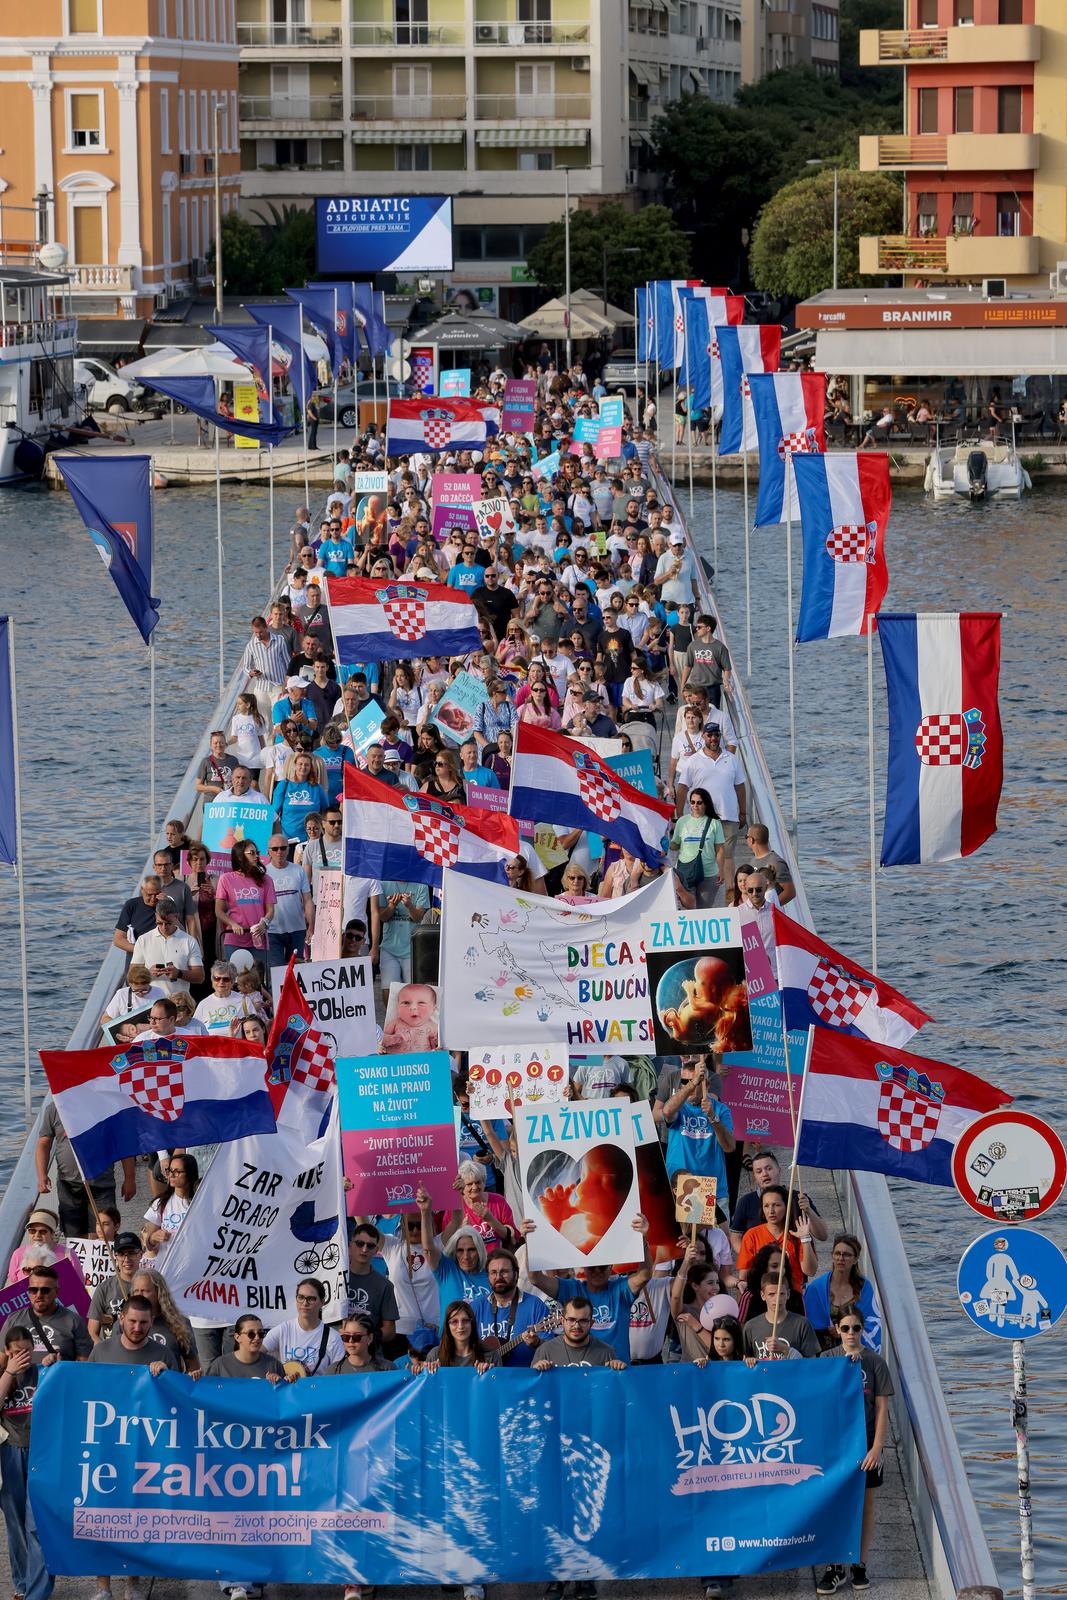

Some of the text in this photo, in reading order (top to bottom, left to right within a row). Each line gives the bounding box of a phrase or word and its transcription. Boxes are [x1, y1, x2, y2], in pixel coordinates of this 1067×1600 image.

[326, 199, 410, 213] ADRIATIC
[326, 213, 410, 222] OSIGURANJE
[882, 310, 952, 322] BRANIMIR
[357, 475, 386, 490] ZA ŽIVOT
[443, 482, 471, 491] 52 DANA
[440, 493, 474, 503] OD ZAČEĆA
[456, 513, 468, 521] DANA
[616, 764, 643, 778] DANA
[208, 806, 268, 821] OVO JE IZBOR
[650, 922, 675, 948] ZA
[679, 915, 732, 946] ŽIVOT
[567, 941, 634, 968] DJECA
[311, 964, 366, 993] niSAM
[578, 974, 648, 1003] BUDUĆN
[762, 1031, 777, 1042] IMA
[354, 1063, 431, 1080] “SVAKO LJUDSKO
[470, 1062, 562, 1086] ŽIVOT
[358, 1080, 431, 1097] BIĆE IMA PRAVO
[764, 1078, 796, 1092] POČINE
[372, 1098, 419, 1113] NA ŽIVOT”
[381, 1114, 402, 1122] Ustav
[403, 1111, 417, 1121] RH
[525, 1114, 556, 1144] ZA
[559, 1106, 622, 1141] ŽIVOT
[682, 1114, 708, 1128] HOD
[746, 1117, 770, 1128] HOD
[363, 1134, 434, 1151] “ŽIVOT POČINJE
[376, 1152, 423, 1167] ZAČEĆEM”
[234, 1162, 283, 1197] ZAR
[377, 1167, 416, 1177] medicinska
[416, 1165, 447, 1175] fakulteta
[385, 1183, 413, 1197] HOD
[221, 1194, 280, 1229] DRAGO
[213, 1222, 270, 1255] ŠTO JE
[69, 1240, 87, 1255] ZA
[202, 1254, 258, 1281] TVOJA
[183, 1279, 287, 1310] MAMA BILA
[80, 1399, 333, 1450] Prvi korak
[670, 1392, 797, 1451] HOD
[675, 1438, 804, 1470] ZA ŽIVOT
[73, 1450, 302, 1507] je zakon!
[683, 1477, 695, 1486] ZA
[695, 1474, 720, 1485] ŽIVOT,
[720, 1472, 753, 1481] OBITELJ
[758, 1467, 801, 1479] HRVATSKU
[76, 1511, 132, 1526] Znanost
[134, 1513, 149, 1528] je
[151, 1514, 211, 1530] potvrdila
[234, 1514, 265, 1529] život
[268, 1514, 318, 1530] počinje
[320, 1514, 386, 1530] začećem.
[75, 1523, 307, 1543] Zaštitimo ga pravednim zakonom.
[738, 1534, 816, 1548] www.hodzazivot.hr
